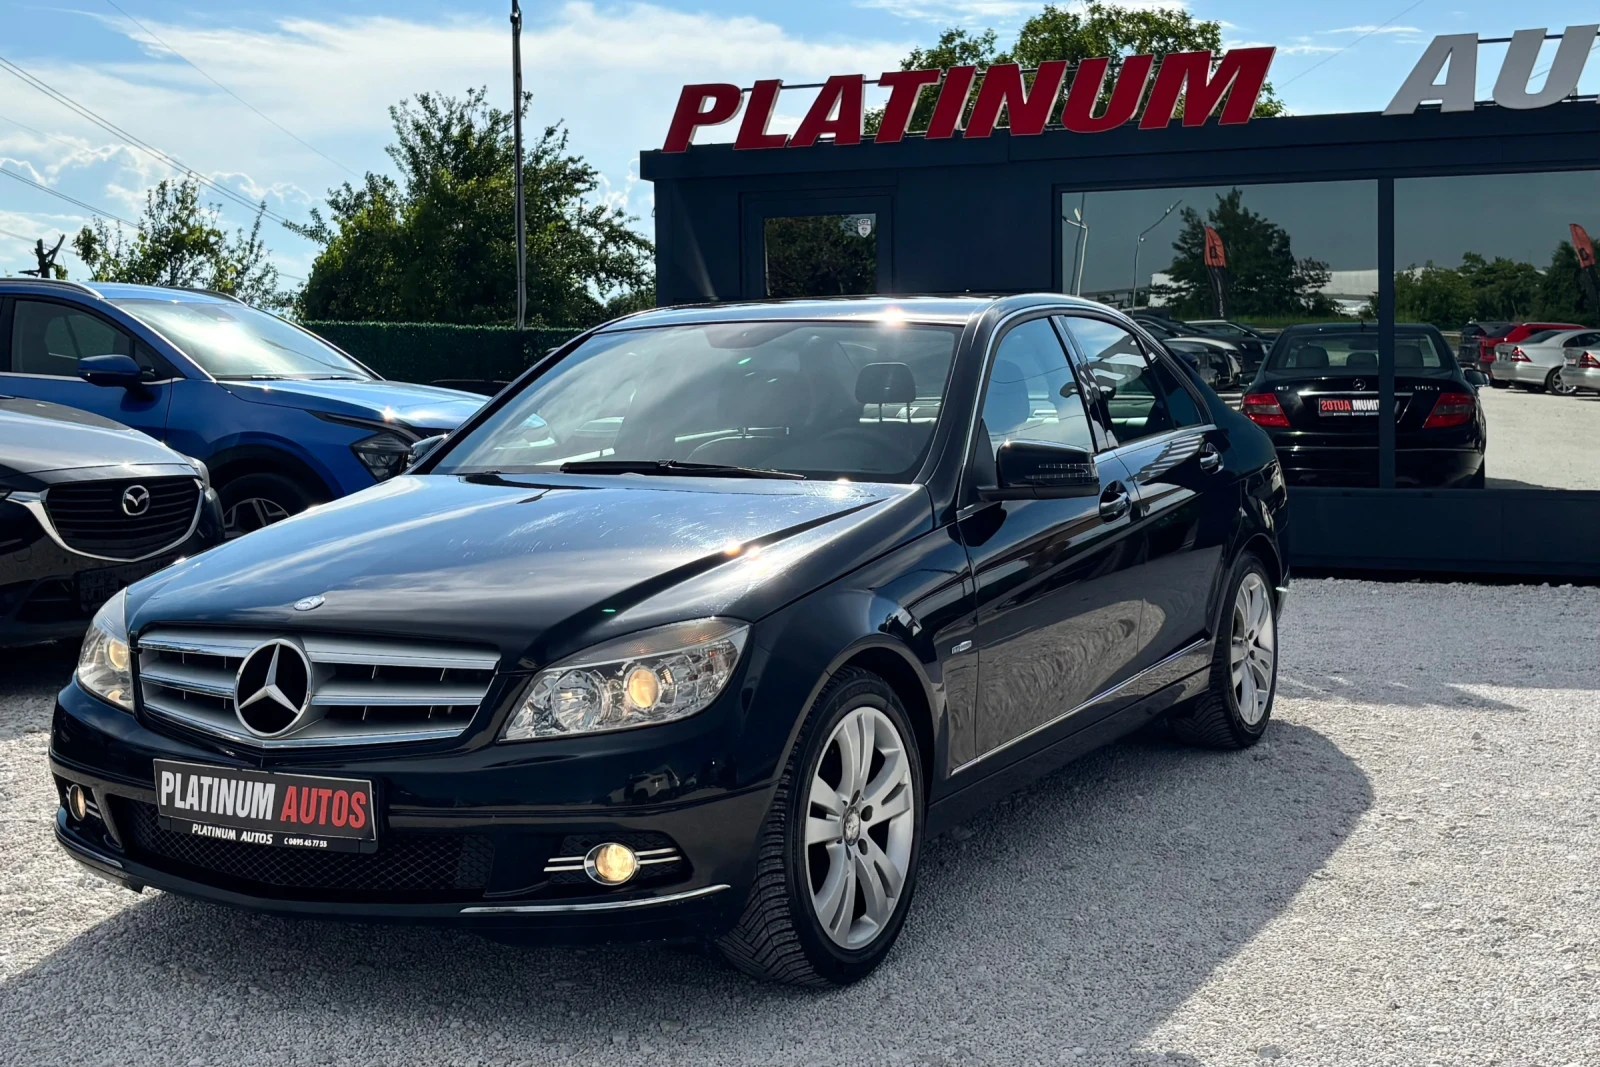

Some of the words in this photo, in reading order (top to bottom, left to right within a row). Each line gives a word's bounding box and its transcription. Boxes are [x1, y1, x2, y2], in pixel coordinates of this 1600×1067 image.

[662, 46, 1276, 153] PLATINUM
[1381, 23, 1600, 116] AU
[161, 770, 276, 821] PLATINUM
[280, 785, 366, 828] AUTOS
[192, 823, 236, 841] PLATINUM
[240, 830, 273, 845] AUTOS
